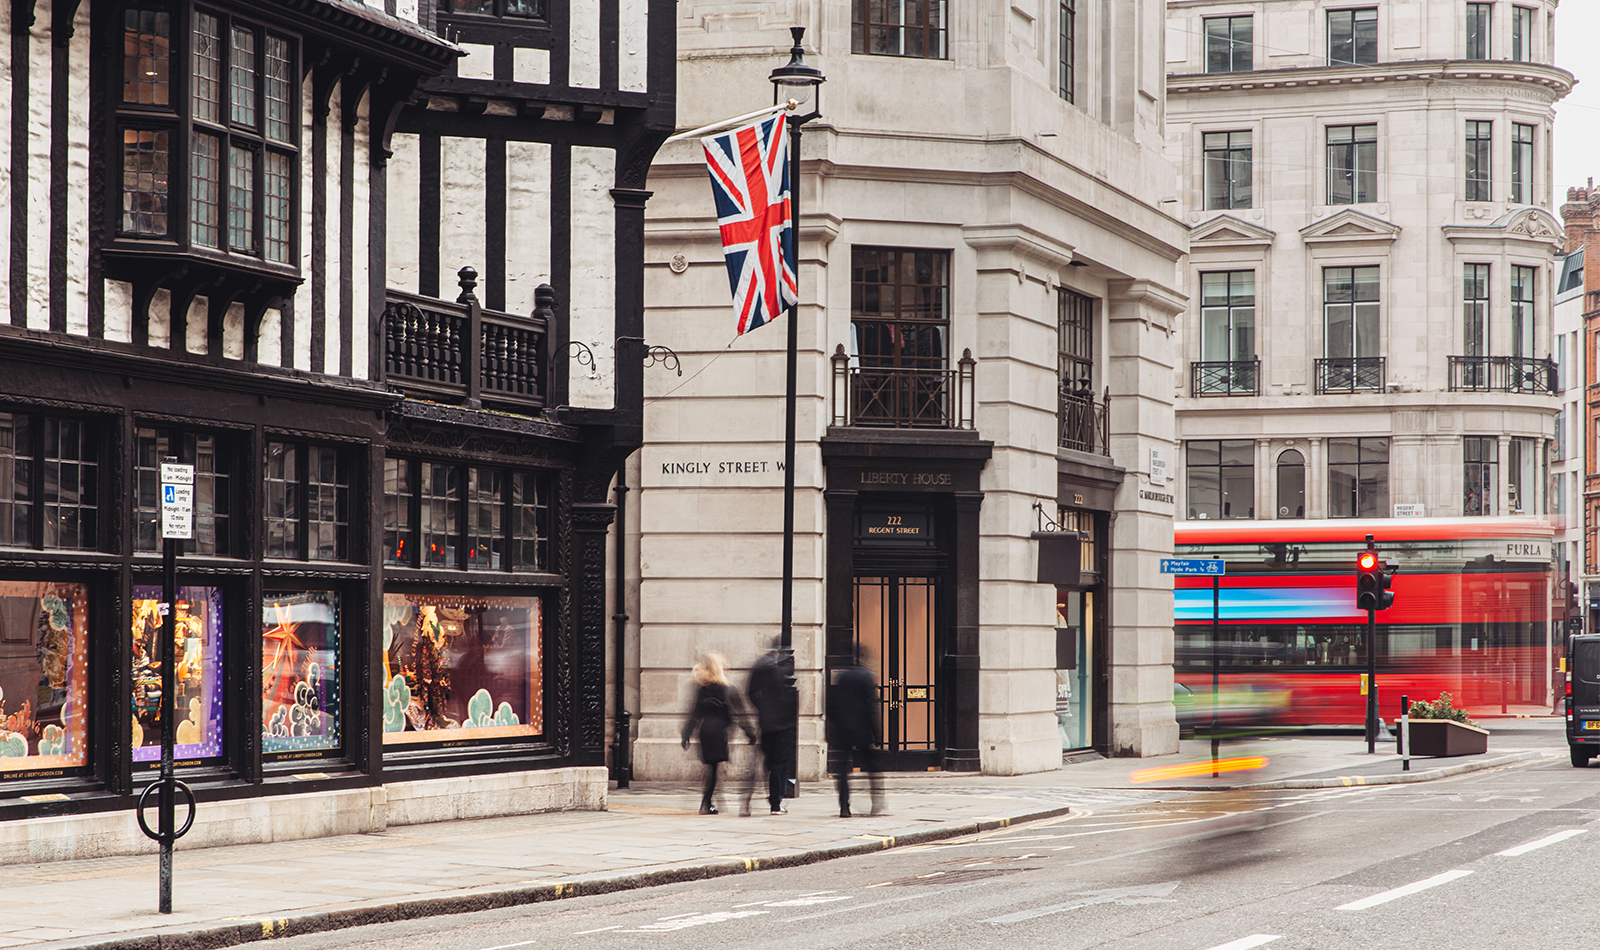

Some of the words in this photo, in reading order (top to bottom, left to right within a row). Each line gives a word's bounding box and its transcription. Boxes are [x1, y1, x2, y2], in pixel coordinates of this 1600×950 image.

[662, 462, 710, 474] KINGLY
[718, 462, 770, 473] STREET.
[860, 472, 908, 484] LIBERTY
[912, 474, 952, 484] HOUSE
[888, 516, 902, 525] 222
[1506, 544, 1542, 556] FURLA
